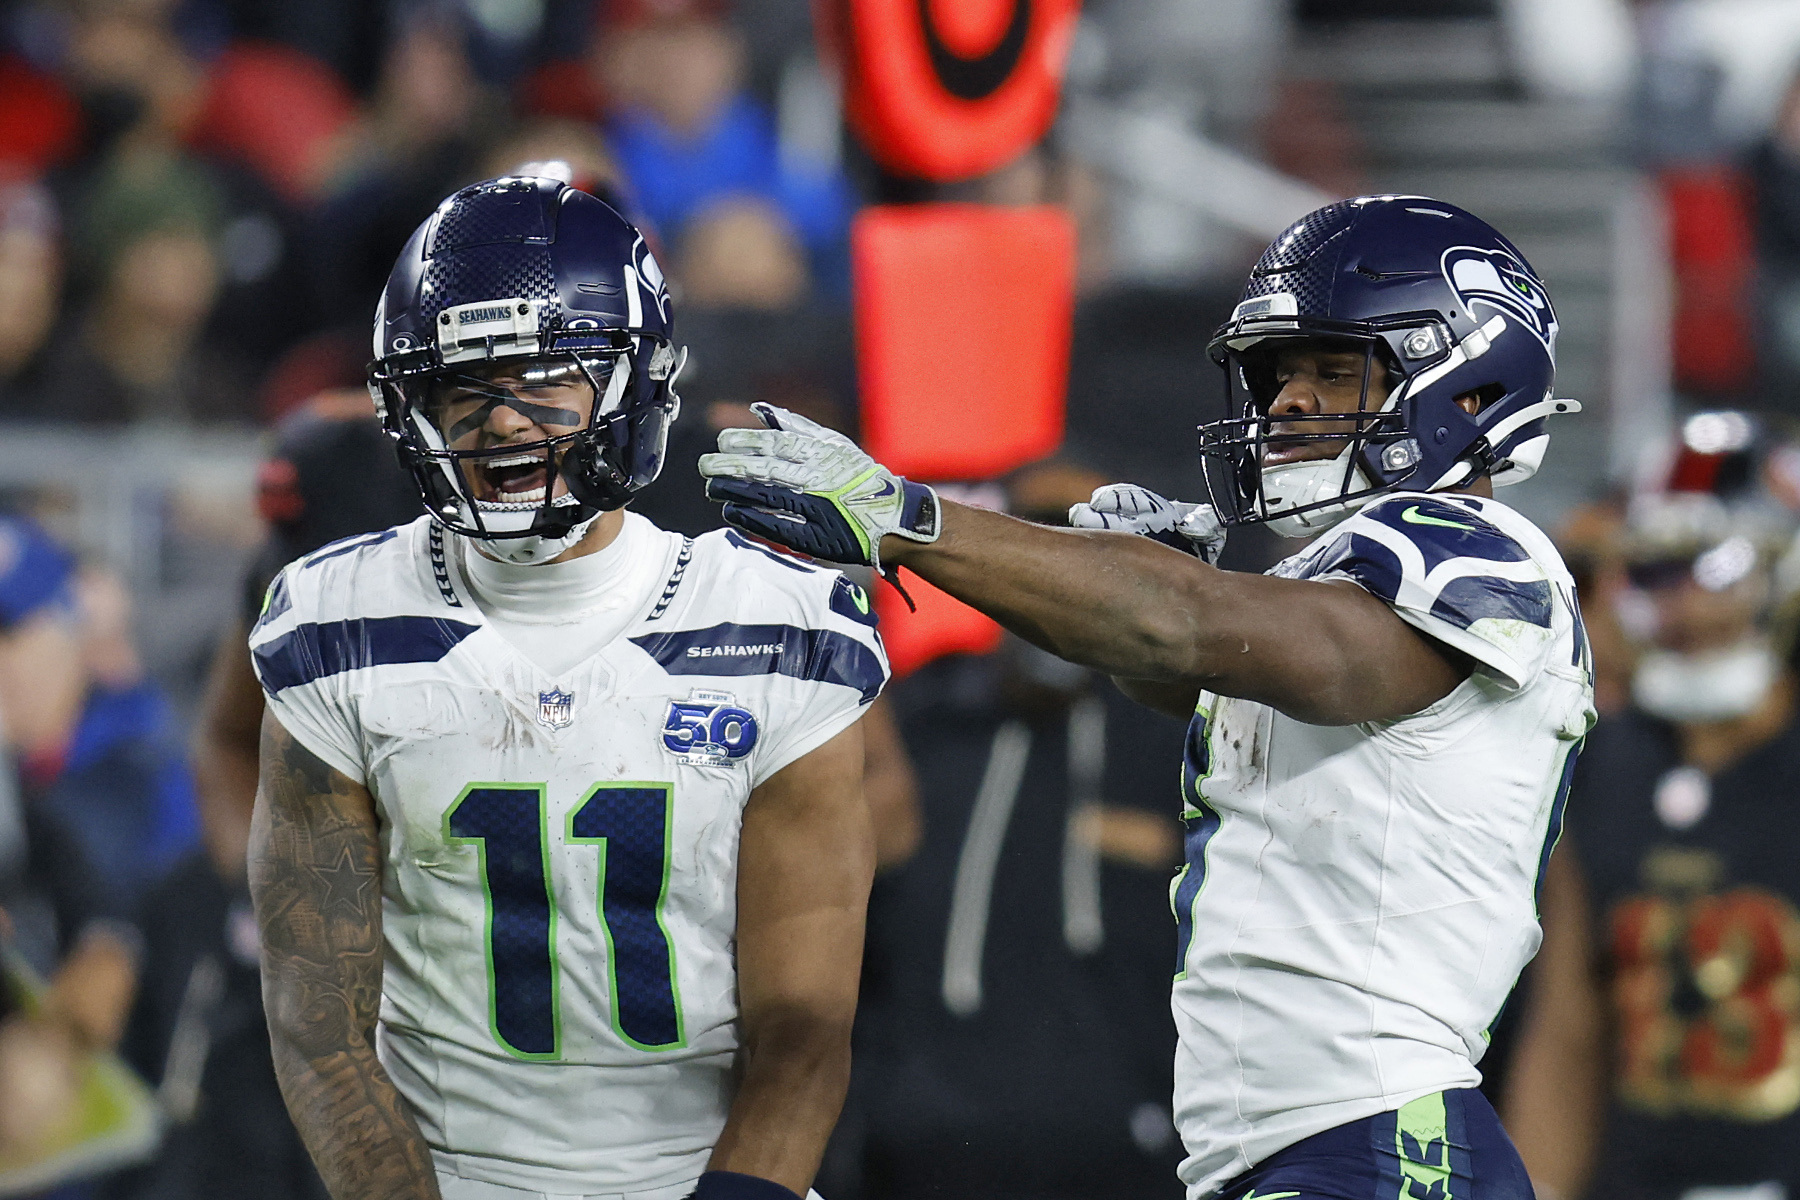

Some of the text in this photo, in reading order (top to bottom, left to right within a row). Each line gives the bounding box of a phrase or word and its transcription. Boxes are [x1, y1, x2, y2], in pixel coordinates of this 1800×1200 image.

[459, 306, 512, 326] SEAHAWKS
[686, 643, 785, 658] SEAHAWKS
[662, 700, 758, 758] 50
[441, 781, 687, 1061] 11
